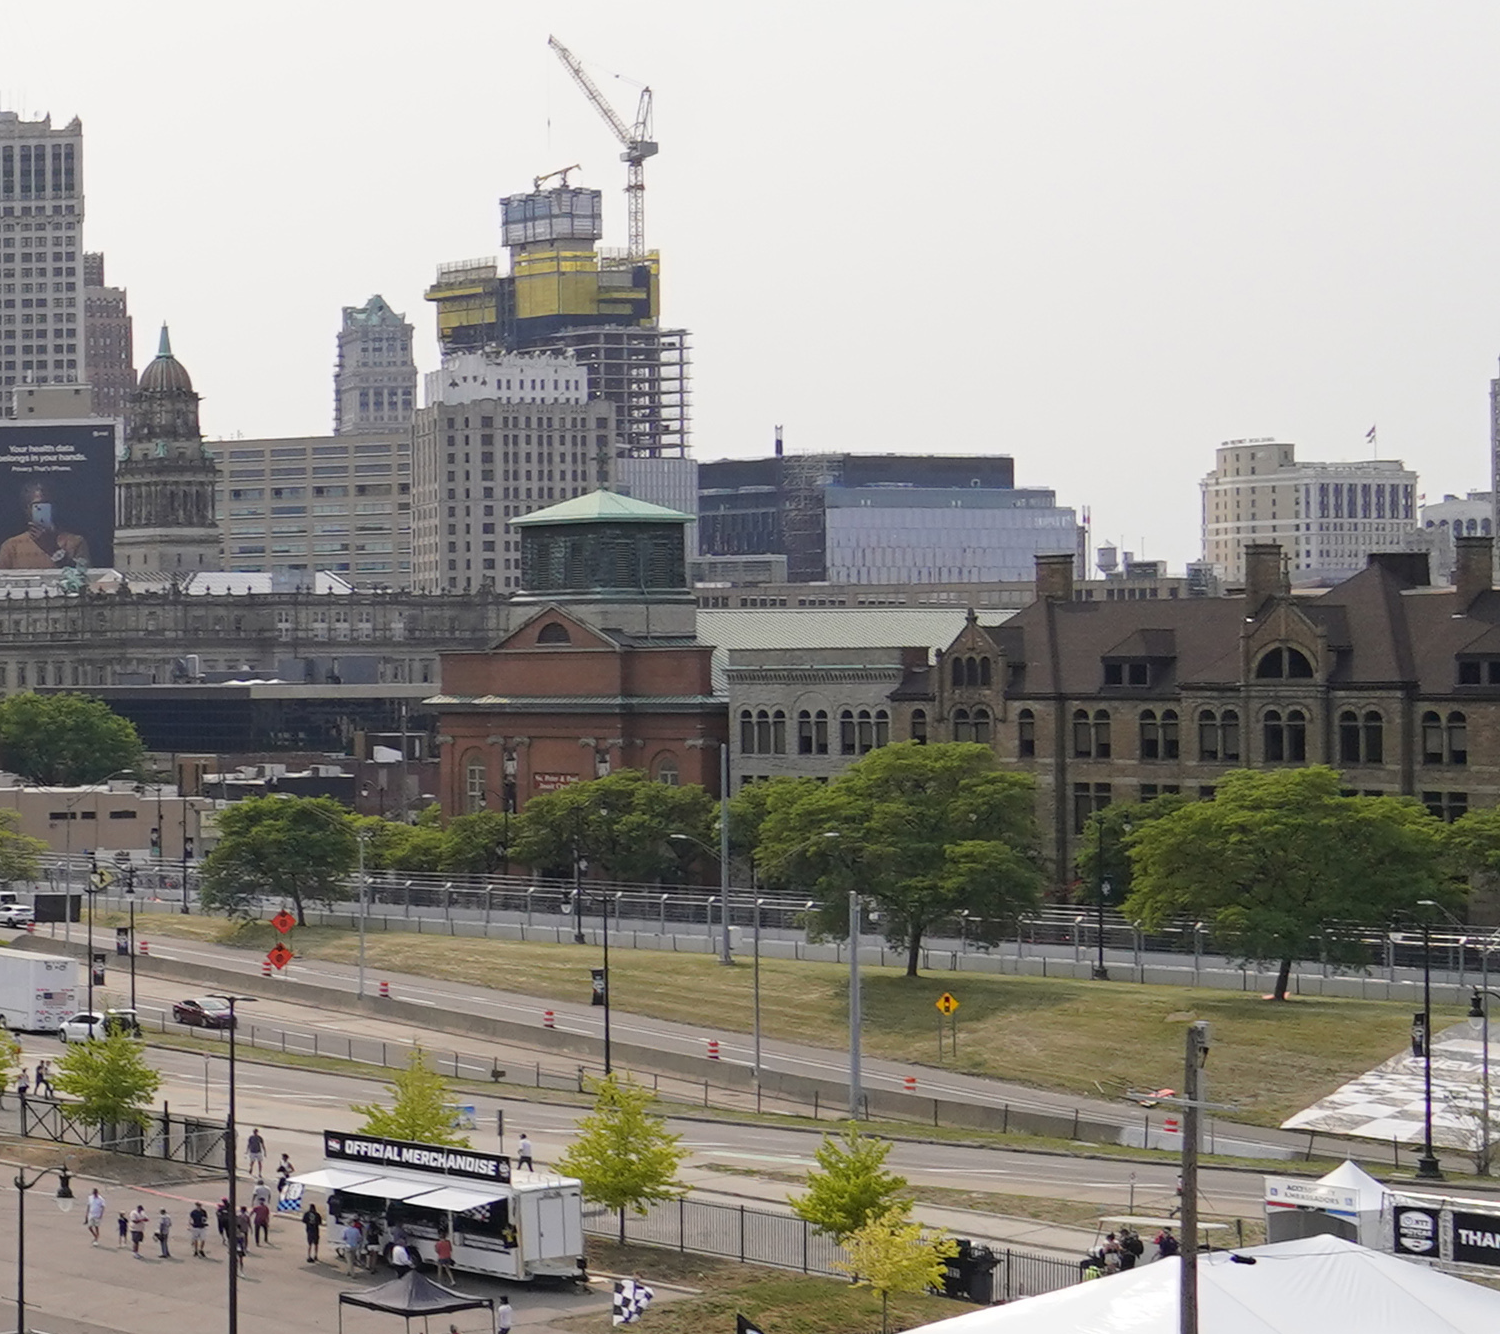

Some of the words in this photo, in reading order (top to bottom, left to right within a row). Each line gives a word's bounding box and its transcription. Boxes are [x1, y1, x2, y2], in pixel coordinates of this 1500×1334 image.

[28, 444, 55, 452] health
[56, 444, 75, 452] data
[40, 455, 58, 464] your
[344, 1140, 401, 1161] OFFICIAL
[401, 1147, 497, 1177] MERCHANDISE
